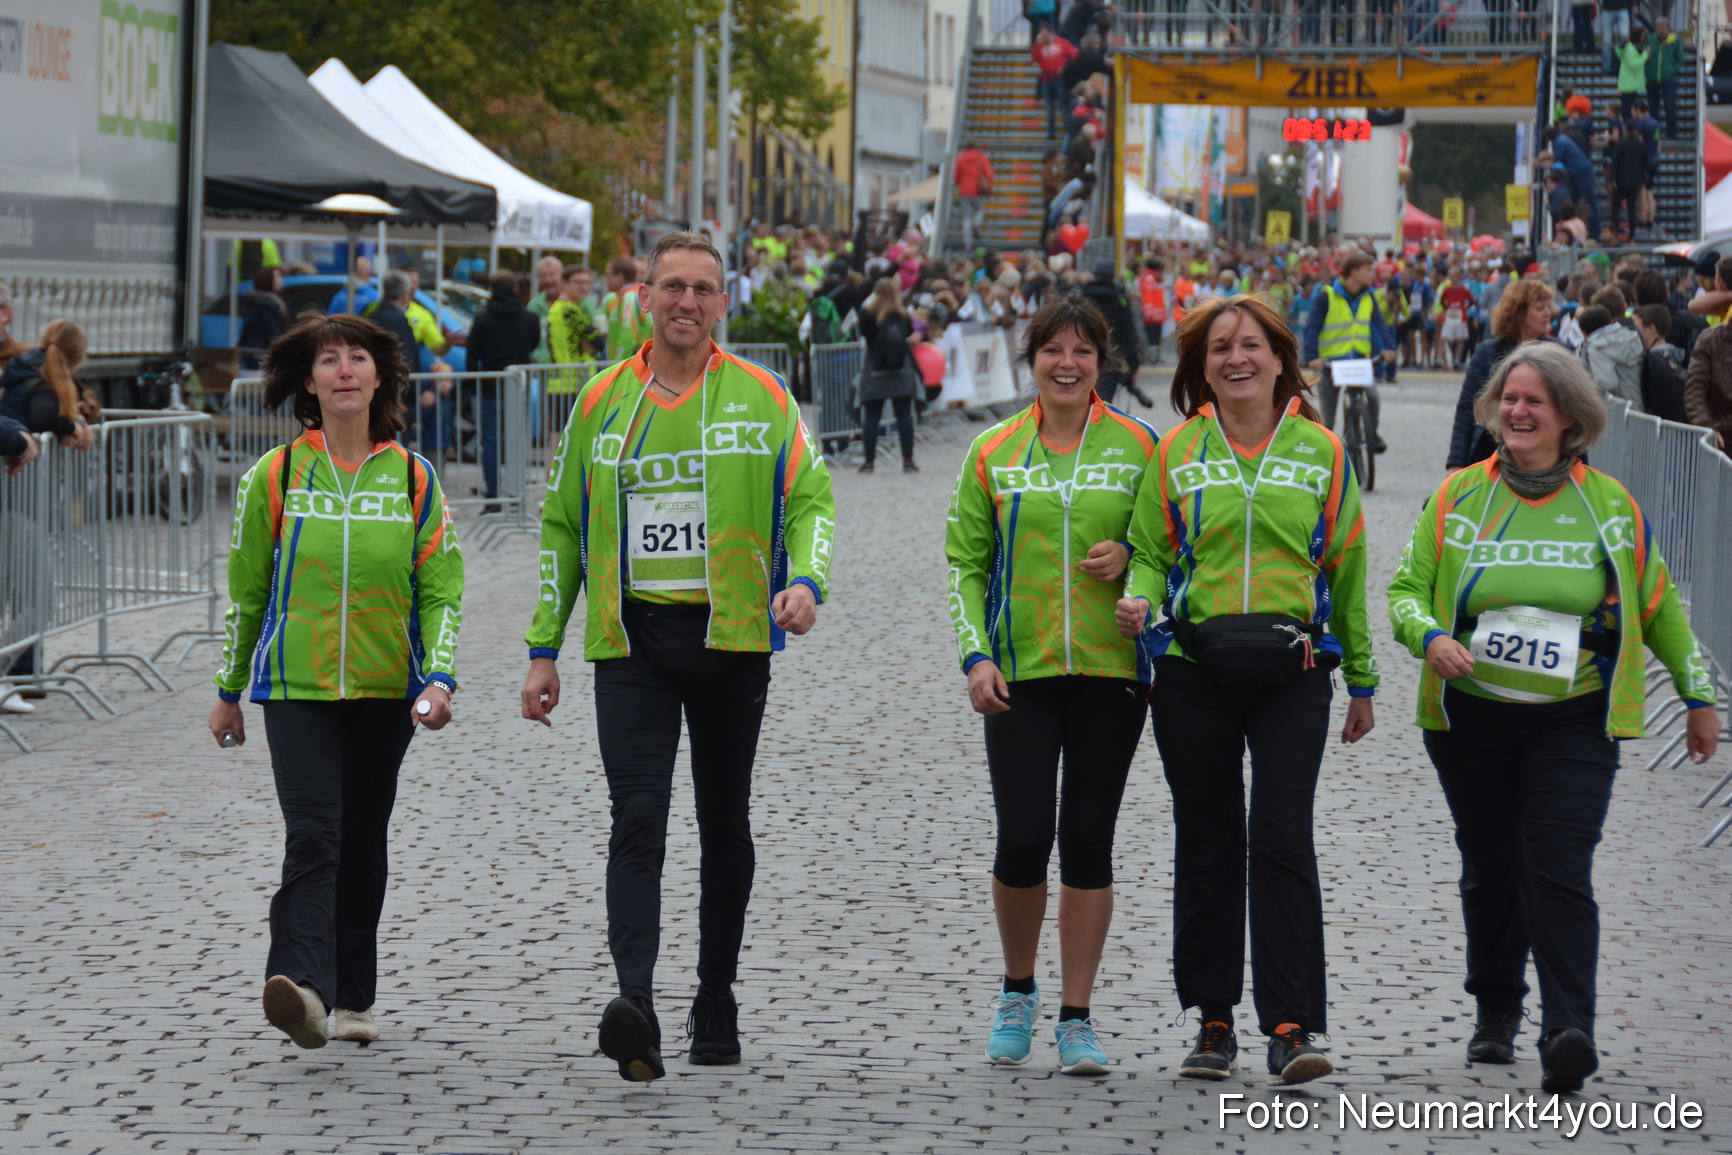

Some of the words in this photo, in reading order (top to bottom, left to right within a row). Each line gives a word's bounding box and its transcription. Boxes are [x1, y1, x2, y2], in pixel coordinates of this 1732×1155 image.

[101, 16, 176, 125] BOCK
[1287, 68, 1377, 98] ZIEL
[284, 488, 414, 523] BOCK
[664, 501, 701, 511] BOCK
[1470, 539, 1597, 569] BOCK
[1516, 615, 1550, 627] BOCK
[1485, 632, 1561, 670] 5215
